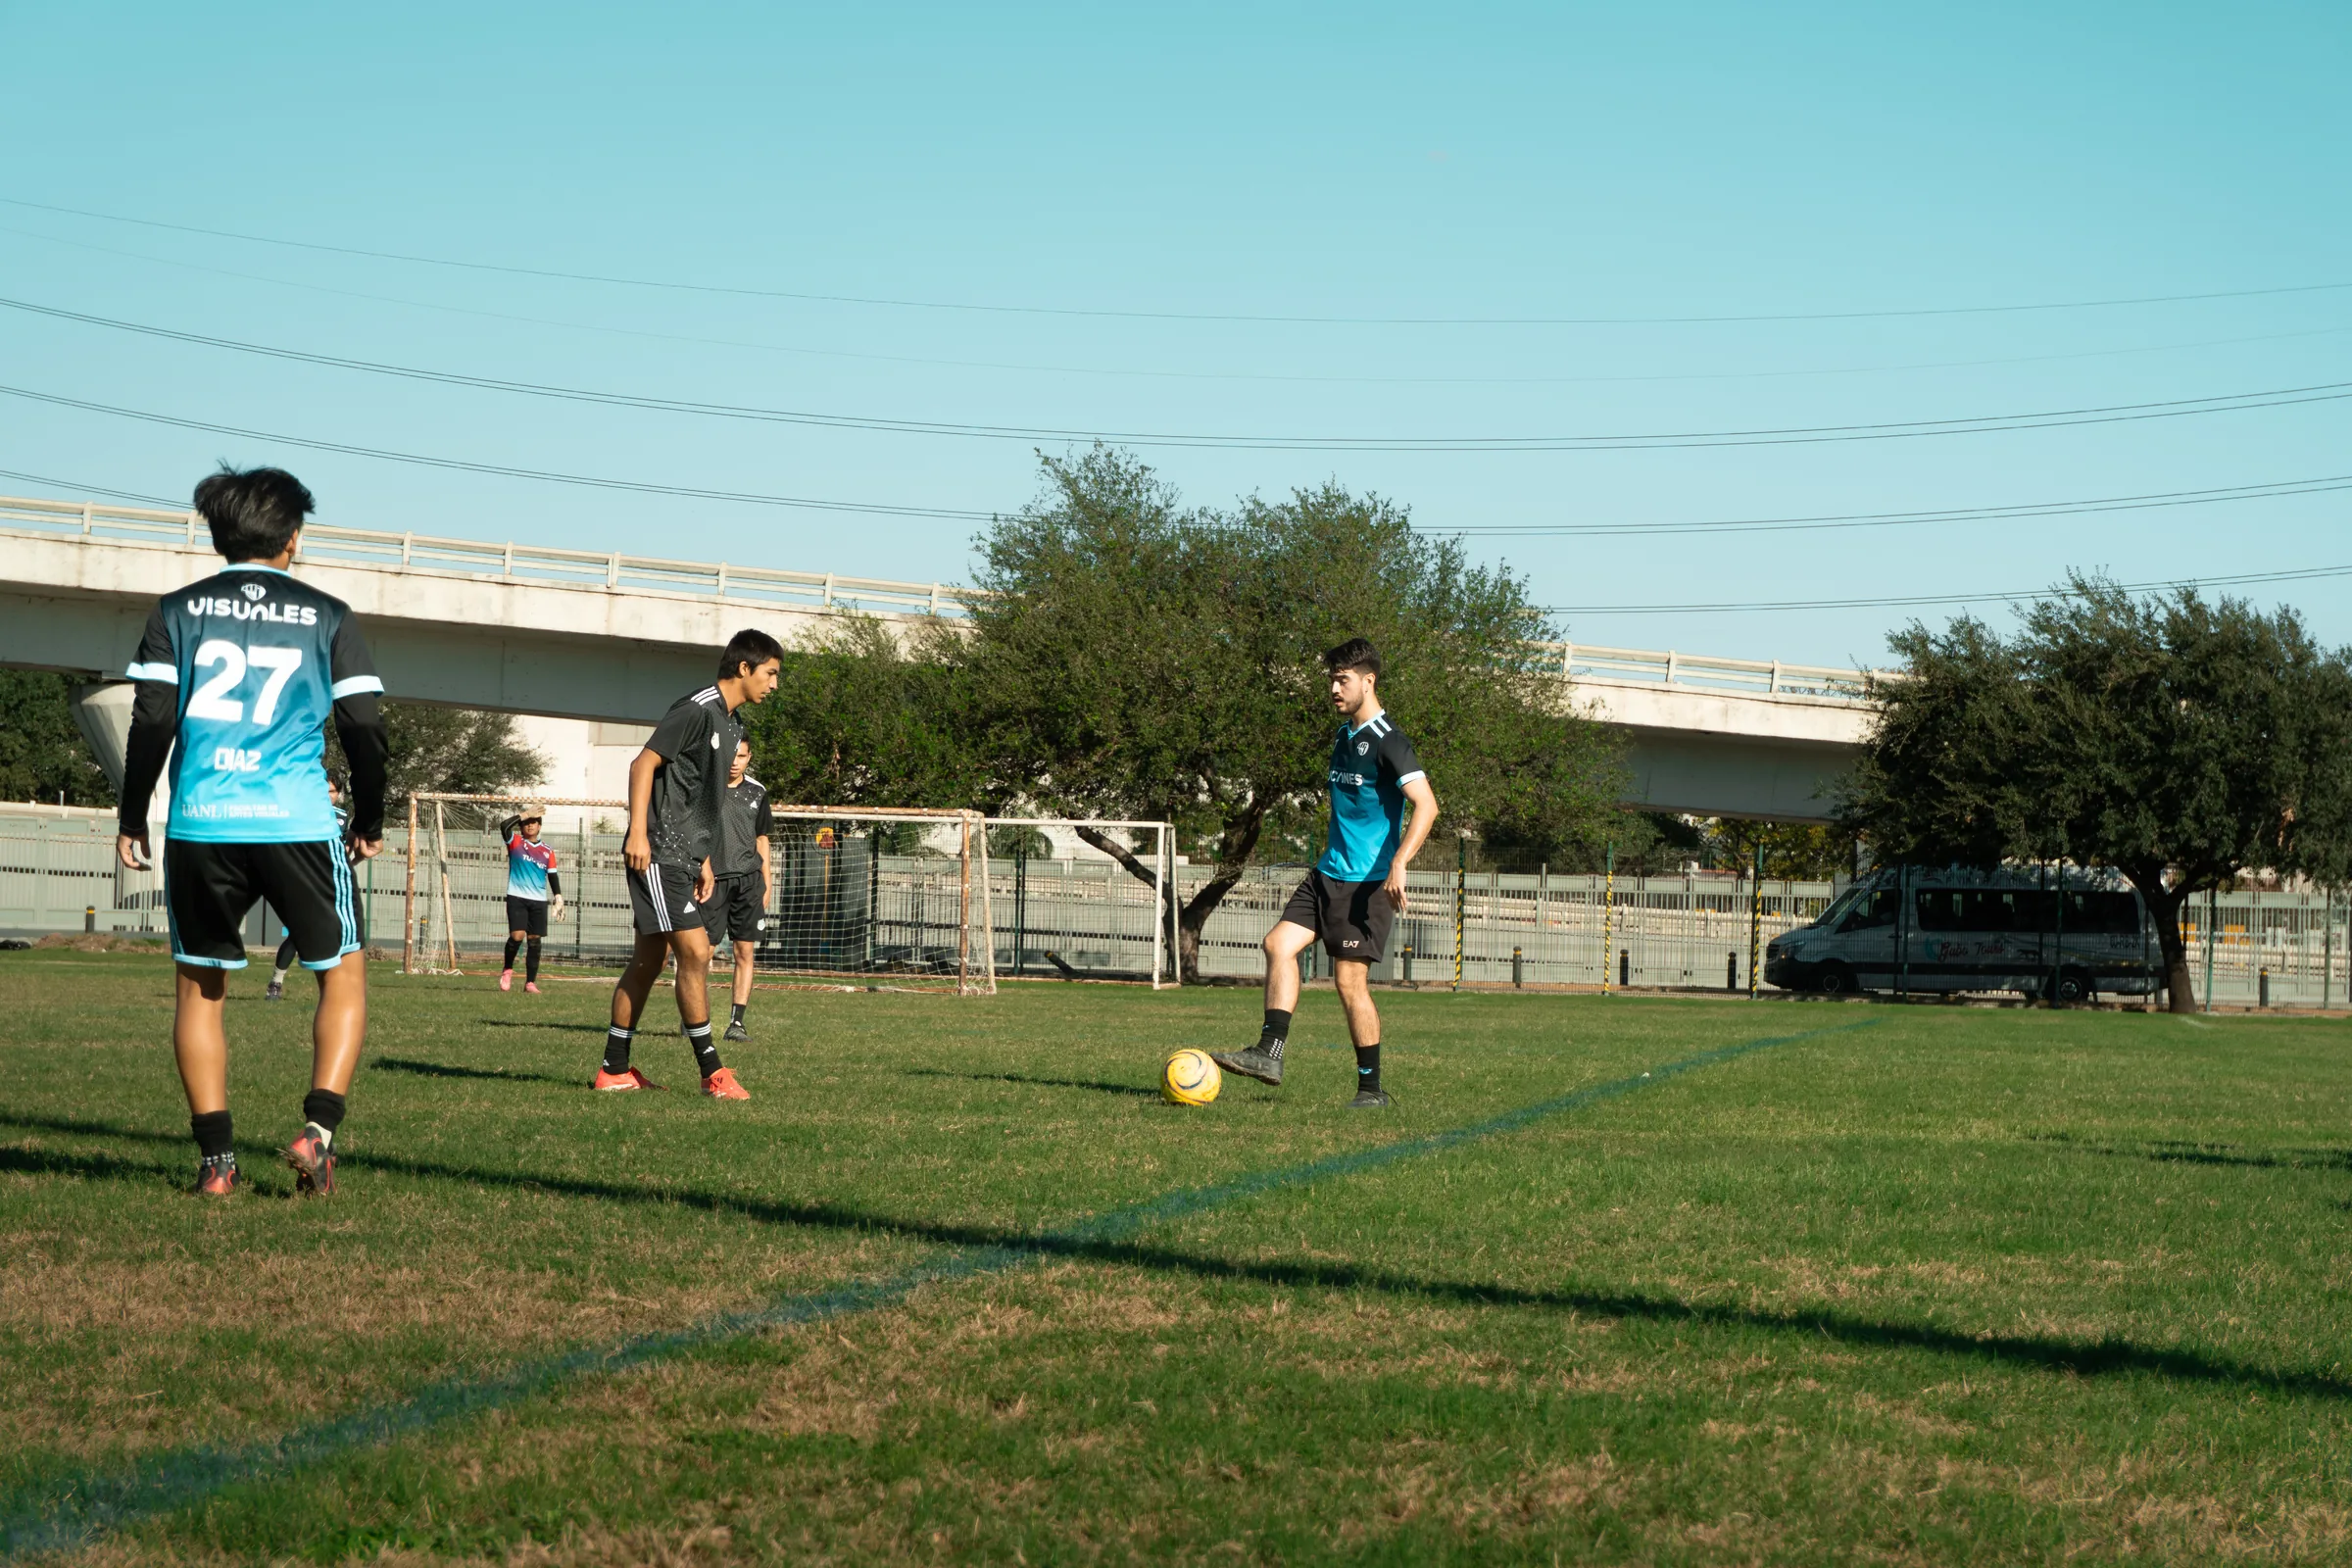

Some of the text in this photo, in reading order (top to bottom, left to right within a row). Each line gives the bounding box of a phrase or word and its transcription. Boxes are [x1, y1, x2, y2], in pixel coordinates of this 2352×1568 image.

[185, 639, 302, 725] 27
[214, 747, 262, 772] DIAZ
[181, 804, 221, 818] UANL
[1343, 940, 1360, 949] EA7
